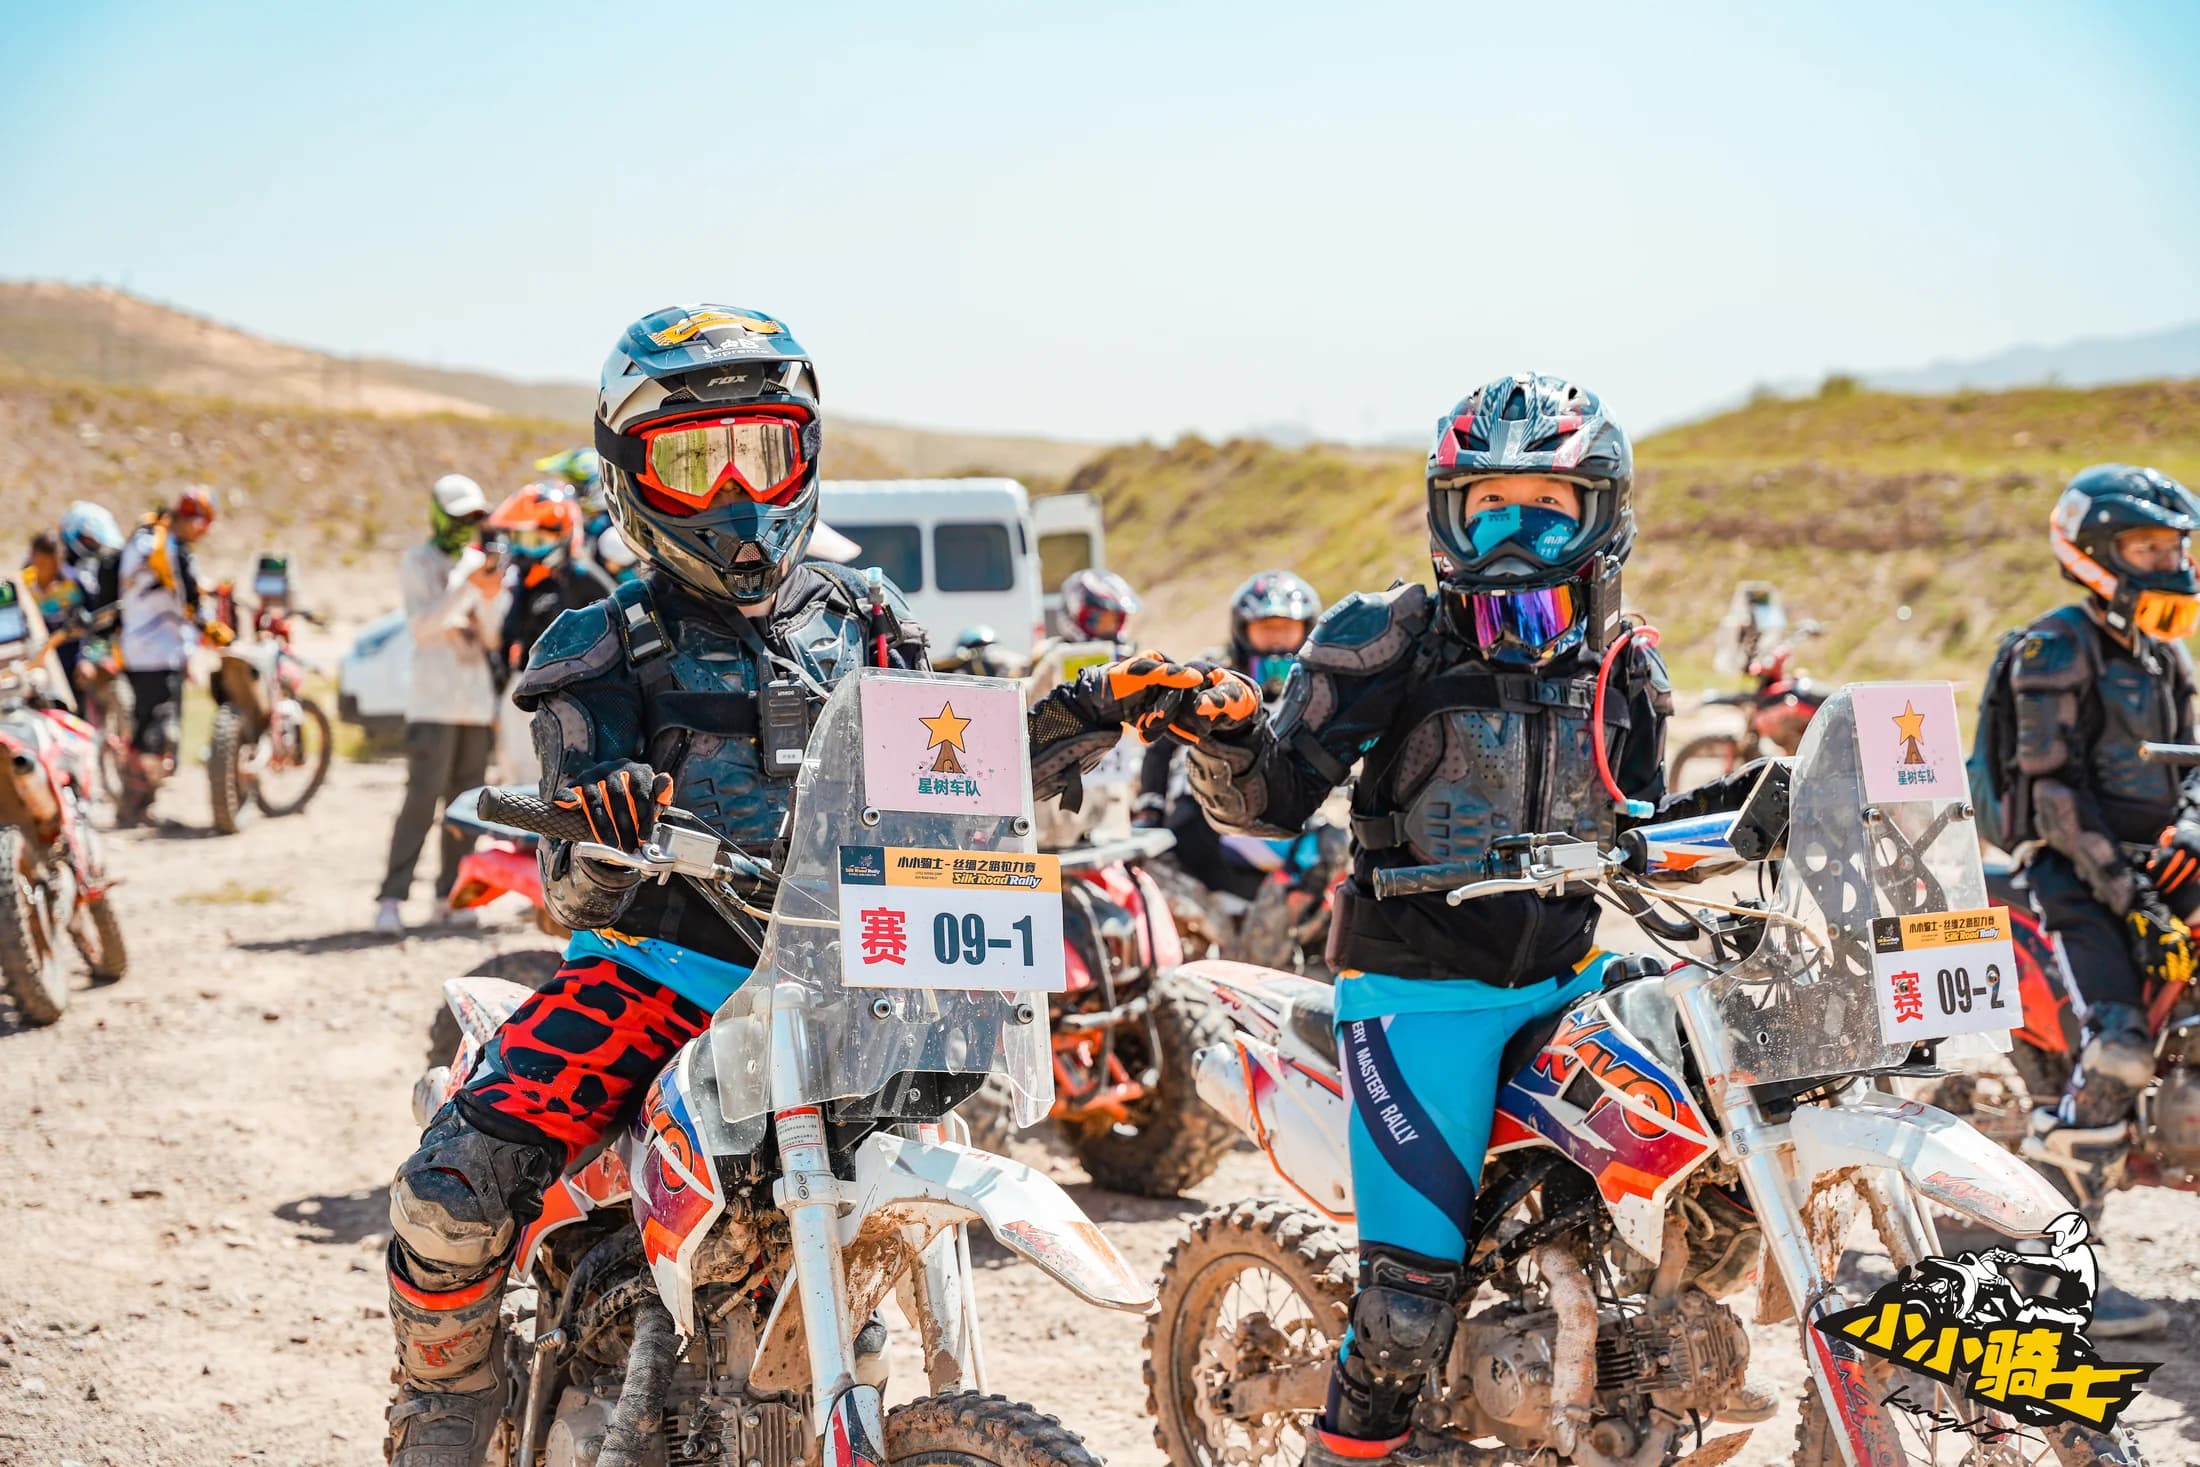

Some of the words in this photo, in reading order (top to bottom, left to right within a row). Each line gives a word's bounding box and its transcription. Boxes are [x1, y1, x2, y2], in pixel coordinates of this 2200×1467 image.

[918, 777, 981, 797] 星树车队
[1897, 769, 1938, 785] 星树车队
[953, 872, 976, 885] Silk
[977, 873, 1008, 886] Road
[1008, 874, 1041, 889] Rally
[860, 906, 908, 966] 赛
[933, 912, 1035, 967] 09-1
[1937, 963, 2005, 1015] 09-2
[1356, 1046, 1391, 1105] MASTERY
[1380, 1103, 1420, 1145] RALLY
